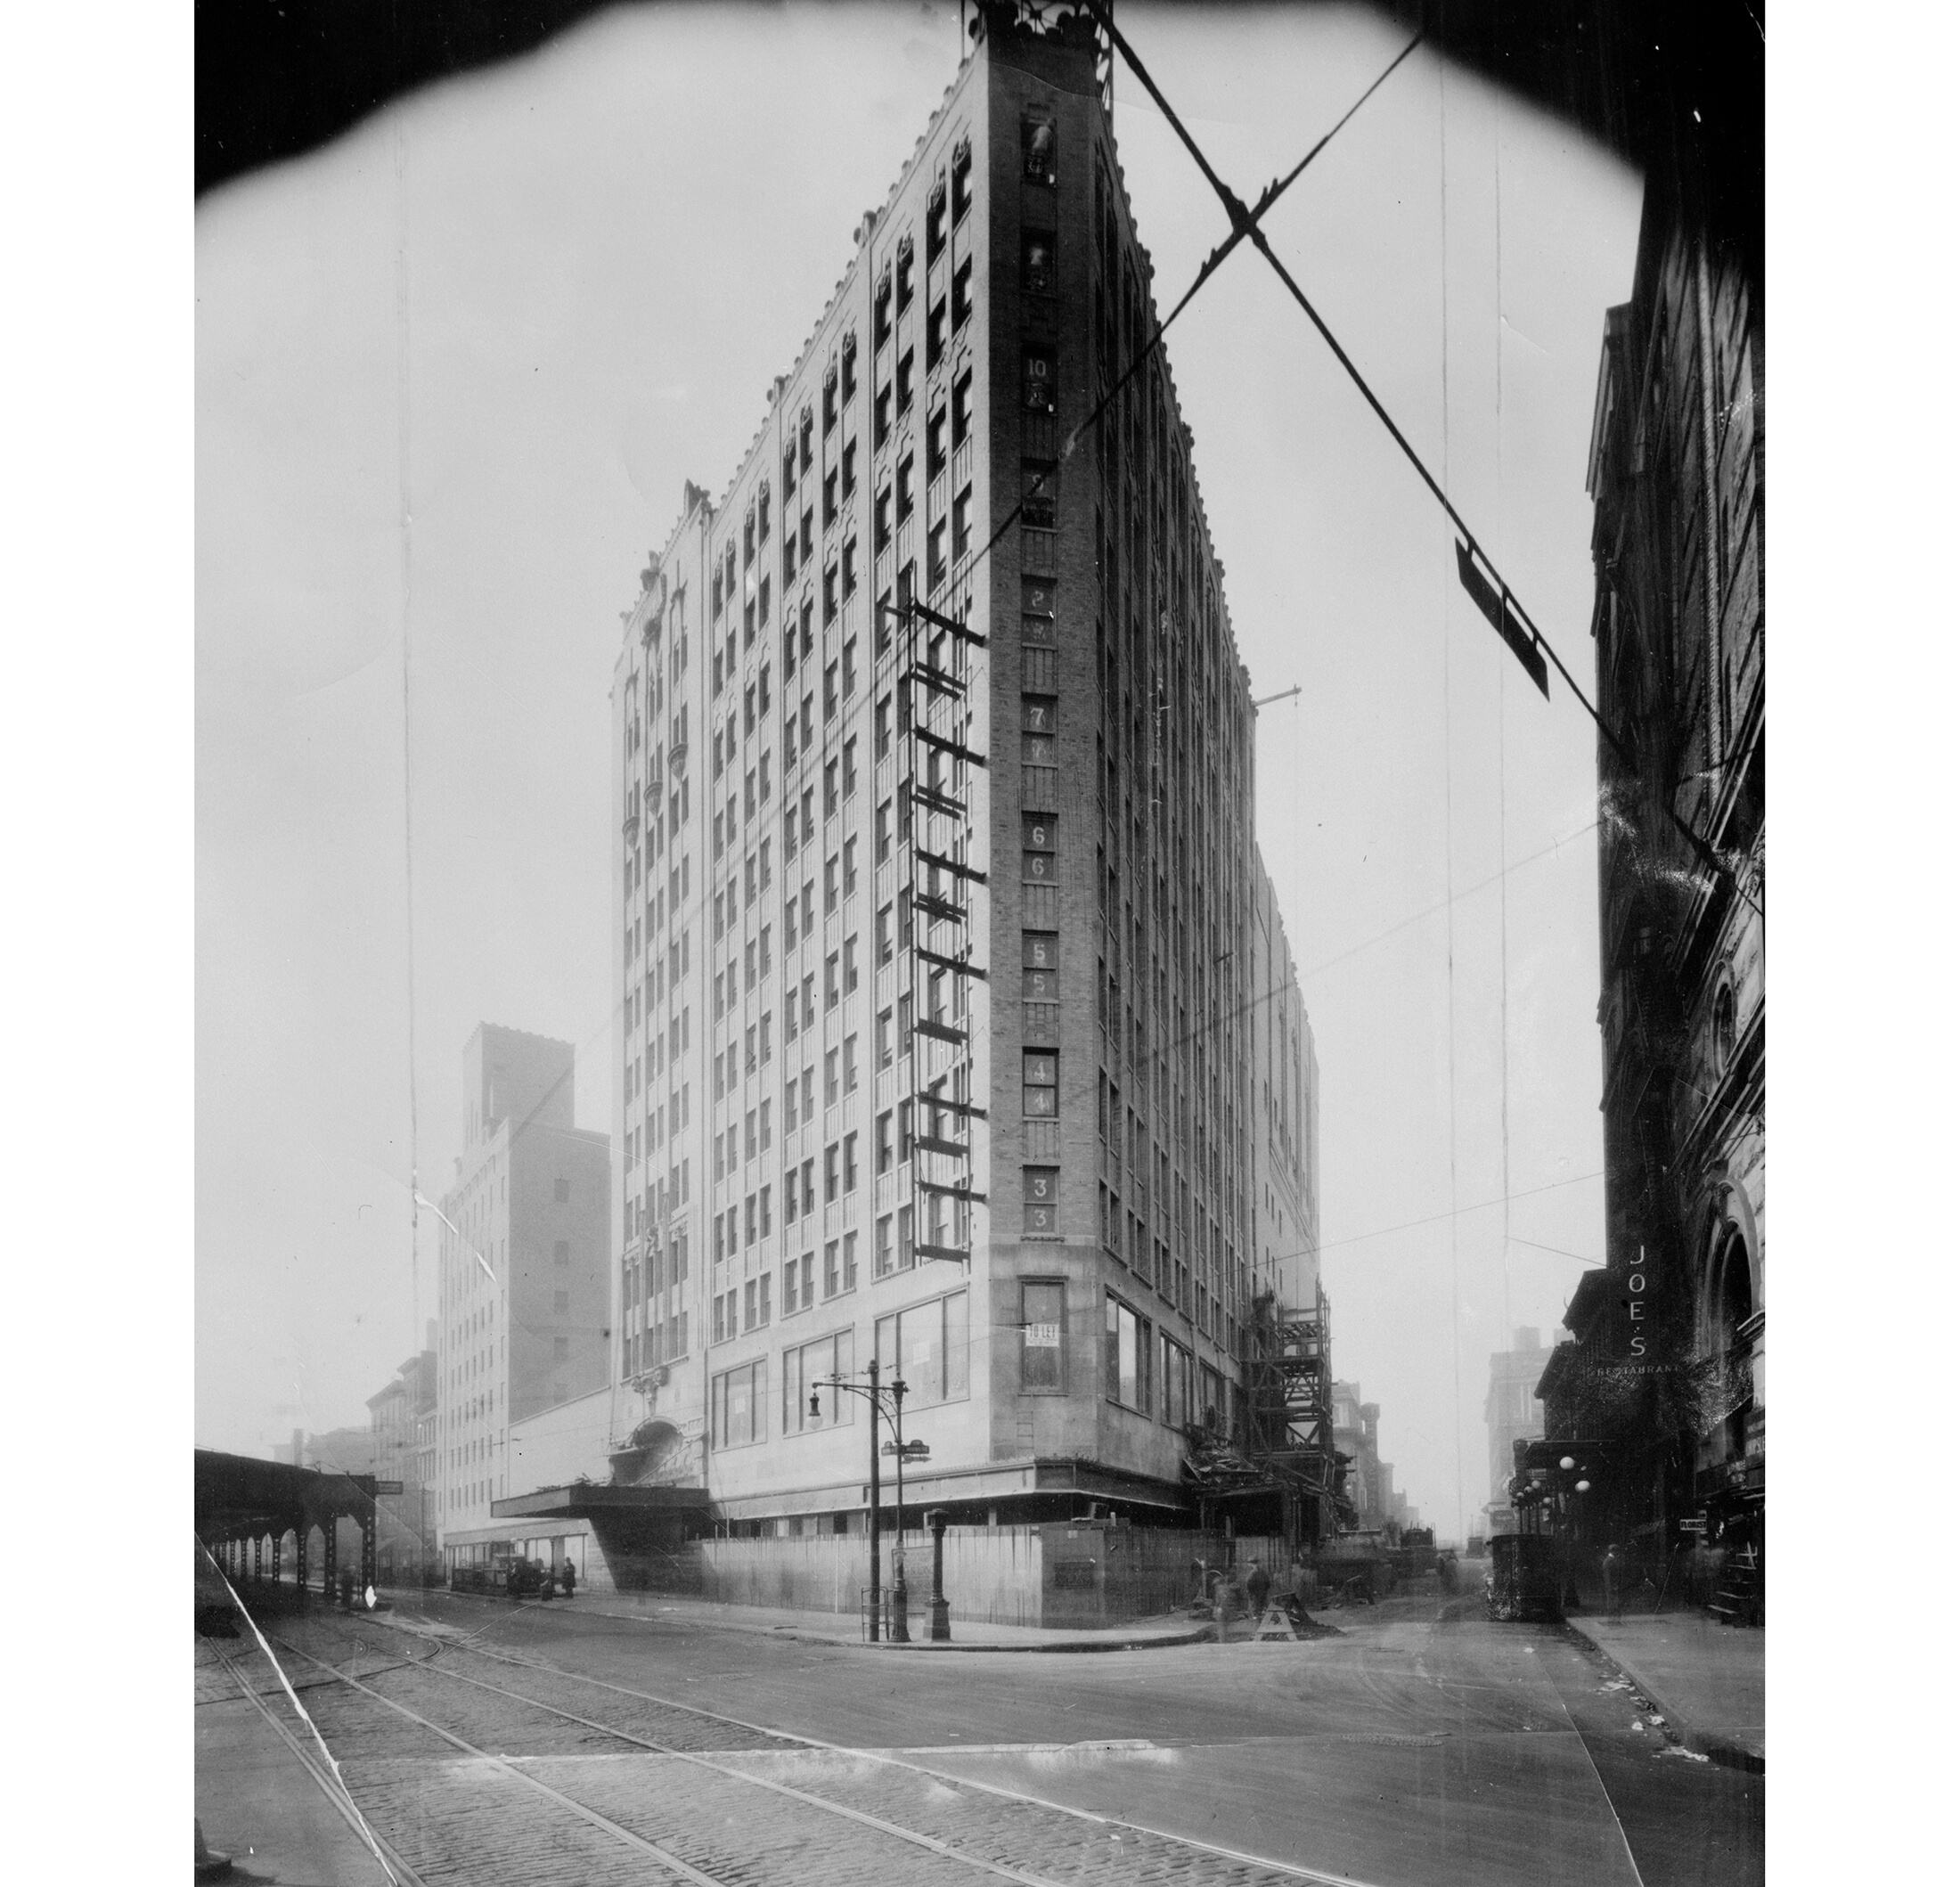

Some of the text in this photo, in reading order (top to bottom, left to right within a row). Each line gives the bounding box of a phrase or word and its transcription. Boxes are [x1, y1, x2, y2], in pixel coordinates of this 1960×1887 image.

[1028, 358, 1047, 377] 10
[1030, 707, 1045, 726] 7
[1033, 826, 1045, 845] 6
[1032, 858, 1044, 876] 6
[1033, 944, 1046, 962] 5
[1033, 975, 1046, 993] 5
[1033, 1061, 1046, 1082] 4
[1033, 1179, 1047, 1197] 3
[1033, 1209, 1047, 1228] 3
[1029, 1325, 1056, 1338] TO LET
[1680, 1521, 1707, 1530] FLORIST
